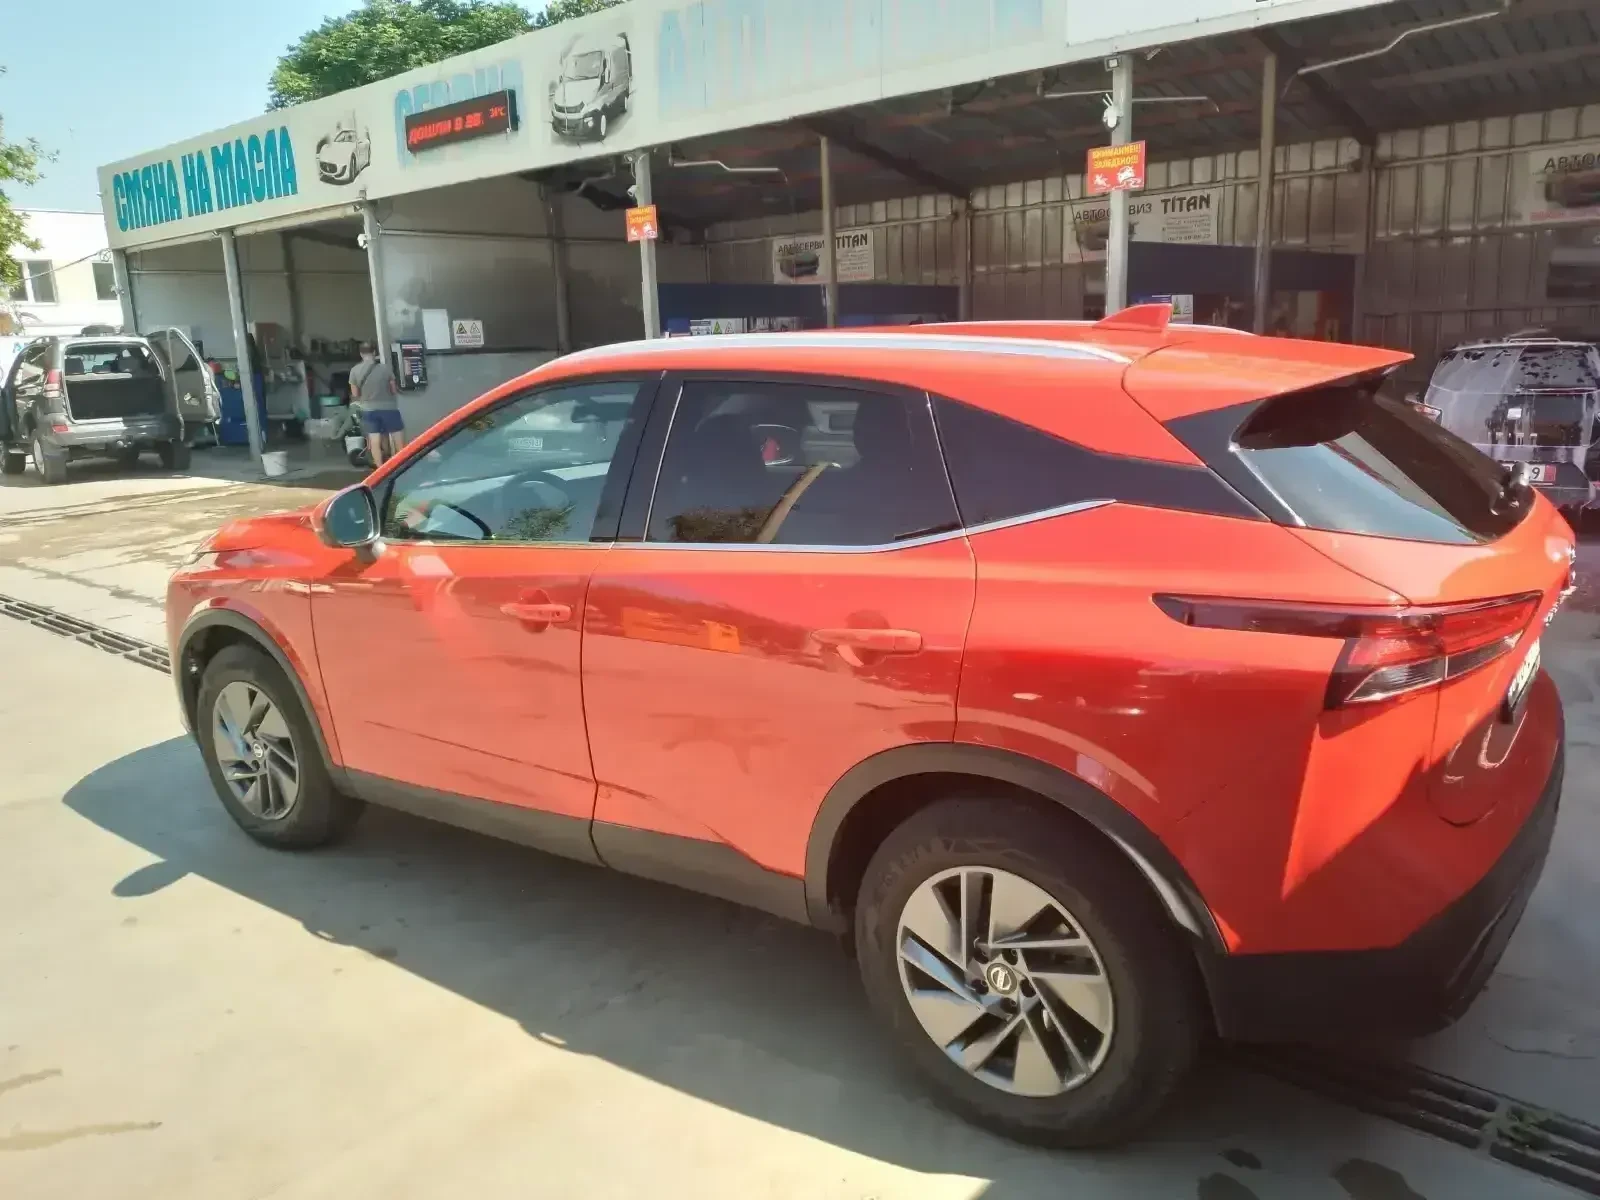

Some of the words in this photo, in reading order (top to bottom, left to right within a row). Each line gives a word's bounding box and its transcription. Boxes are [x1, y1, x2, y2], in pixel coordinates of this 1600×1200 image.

[112, 160, 182, 232] СМЯНА
[181, 150, 214, 218] НА
[210, 125, 299, 211] МАСЛА
[835, 233, 868, 249] TITAN
